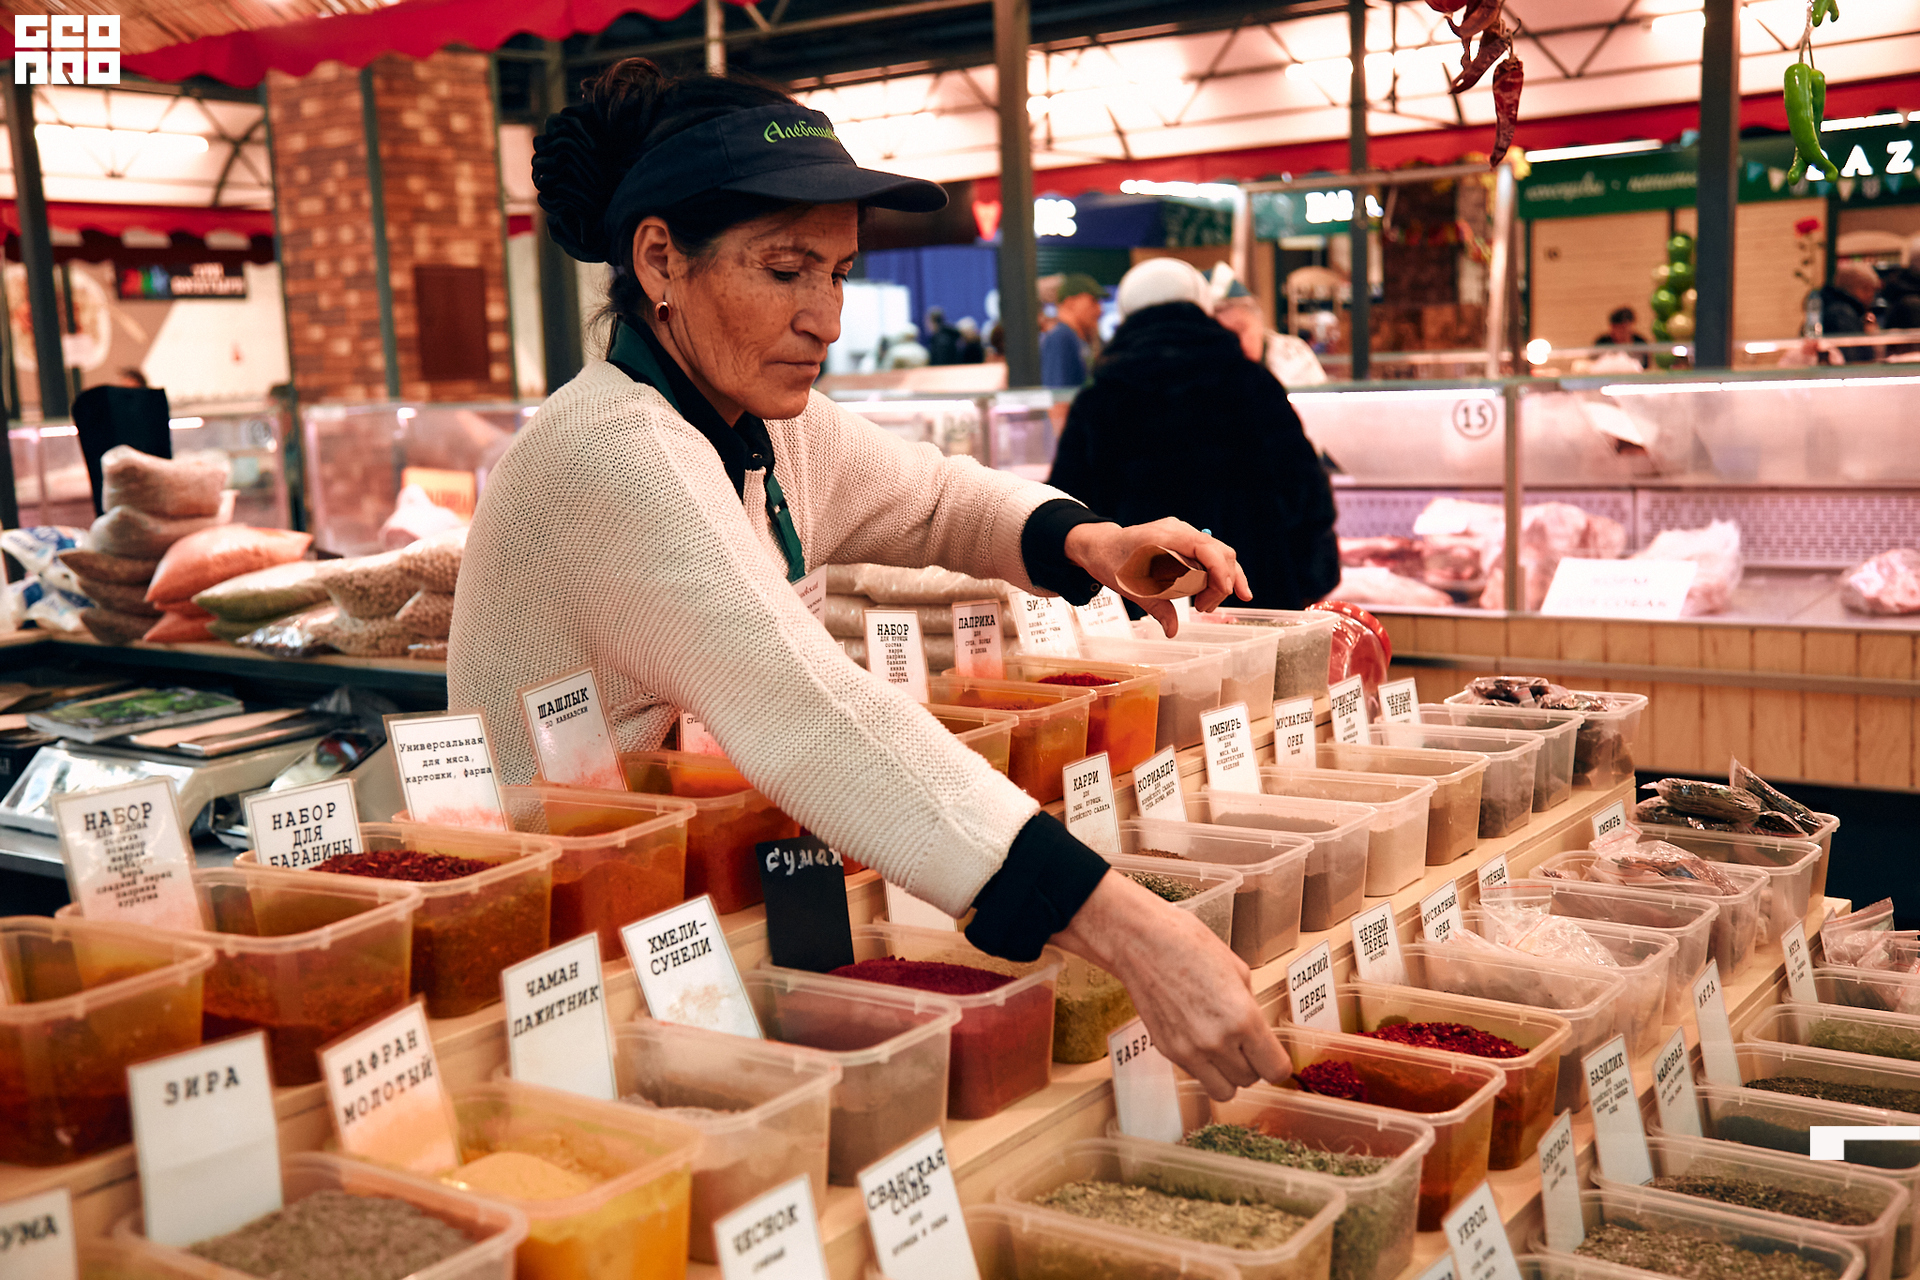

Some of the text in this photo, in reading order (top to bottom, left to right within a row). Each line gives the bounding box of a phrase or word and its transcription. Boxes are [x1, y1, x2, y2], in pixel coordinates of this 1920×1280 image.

[1463, 404, 1487, 428] 15
[877, 623, 909, 636] НАБОР
[958, 614, 996, 629] ПАПРИКА
[537, 687, 590, 720] ШАШЛЫК
[555, 706, 589, 725] КАВКАЗСКИ
[1275, 707, 1314, 730] МУСКАТНЫЙ
[1338, 701, 1358, 719] ПЕРЕЦ
[1390, 702, 1412, 717] ПЕРЕЦ
[1209, 717, 1242, 737] ИМБИРЬ
[1287, 733, 1304, 748] ОРЕХ
[400, 737, 485, 753] Универсальная
[405, 766, 493, 785] картошки, фарша
[422, 755, 475, 768] для мяса,
[1137, 759, 1176, 793] КОРИАНДР
[1073, 770, 1100, 791] КАРРИ
[83, 802, 153, 832] НАБОР
[272, 802, 336, 830] НАБОР
[293, 825, 323, 848] ДЛЯ
[270, 838, 353, 868] БАРАНИНЫ
[1423, 891, 1457, 926] МУСКАТНЫЙ
[648, 920, 708, 954] ХМЕЛИ-
[1358, 914, 1389, 943] ЧЁРНЫЙ
[1434, 919, 1451, 938] ОРЕХ
[650, 937, 713, 976] СУНЕЛИ
[1363, 932, 1389, 956] ПЕРЕЦ
[526, 961, 579, 998] ЧАМАН
[1291, 952, 1329, 992] СЛАДКИЙ
[1299, 983, 1327, 1014] ПЕРЕЦ
[1698, 980, 1717, 1008] МЯТА
[513, 985, 600, 1038] ПАЖИТНИК
[342, 1028, 418, 1086] ШАФРАН
[1116, 1034, 1154, 1066] ЧАБР
[1657, 1042, 1684, 1087] МАЙОРАН
[1590, 1052, 1624, 1087] БАЗИЛИК
[164, 1066, 241, 1106] ЗИРА
[343, 1056, 435, 1125] МОЛОТЫЙ
[1543, 1129, 1570, 1174] ОРЕГАНО
[866, 1148, 946, 1210] СВАНСКАЯ
[891, 1176, 931, 1215] СОЛЬ
[733, 1203, 799, 1256] ЧЕСНОК
[1457, 1205, 1488, 1246] УКРОП
